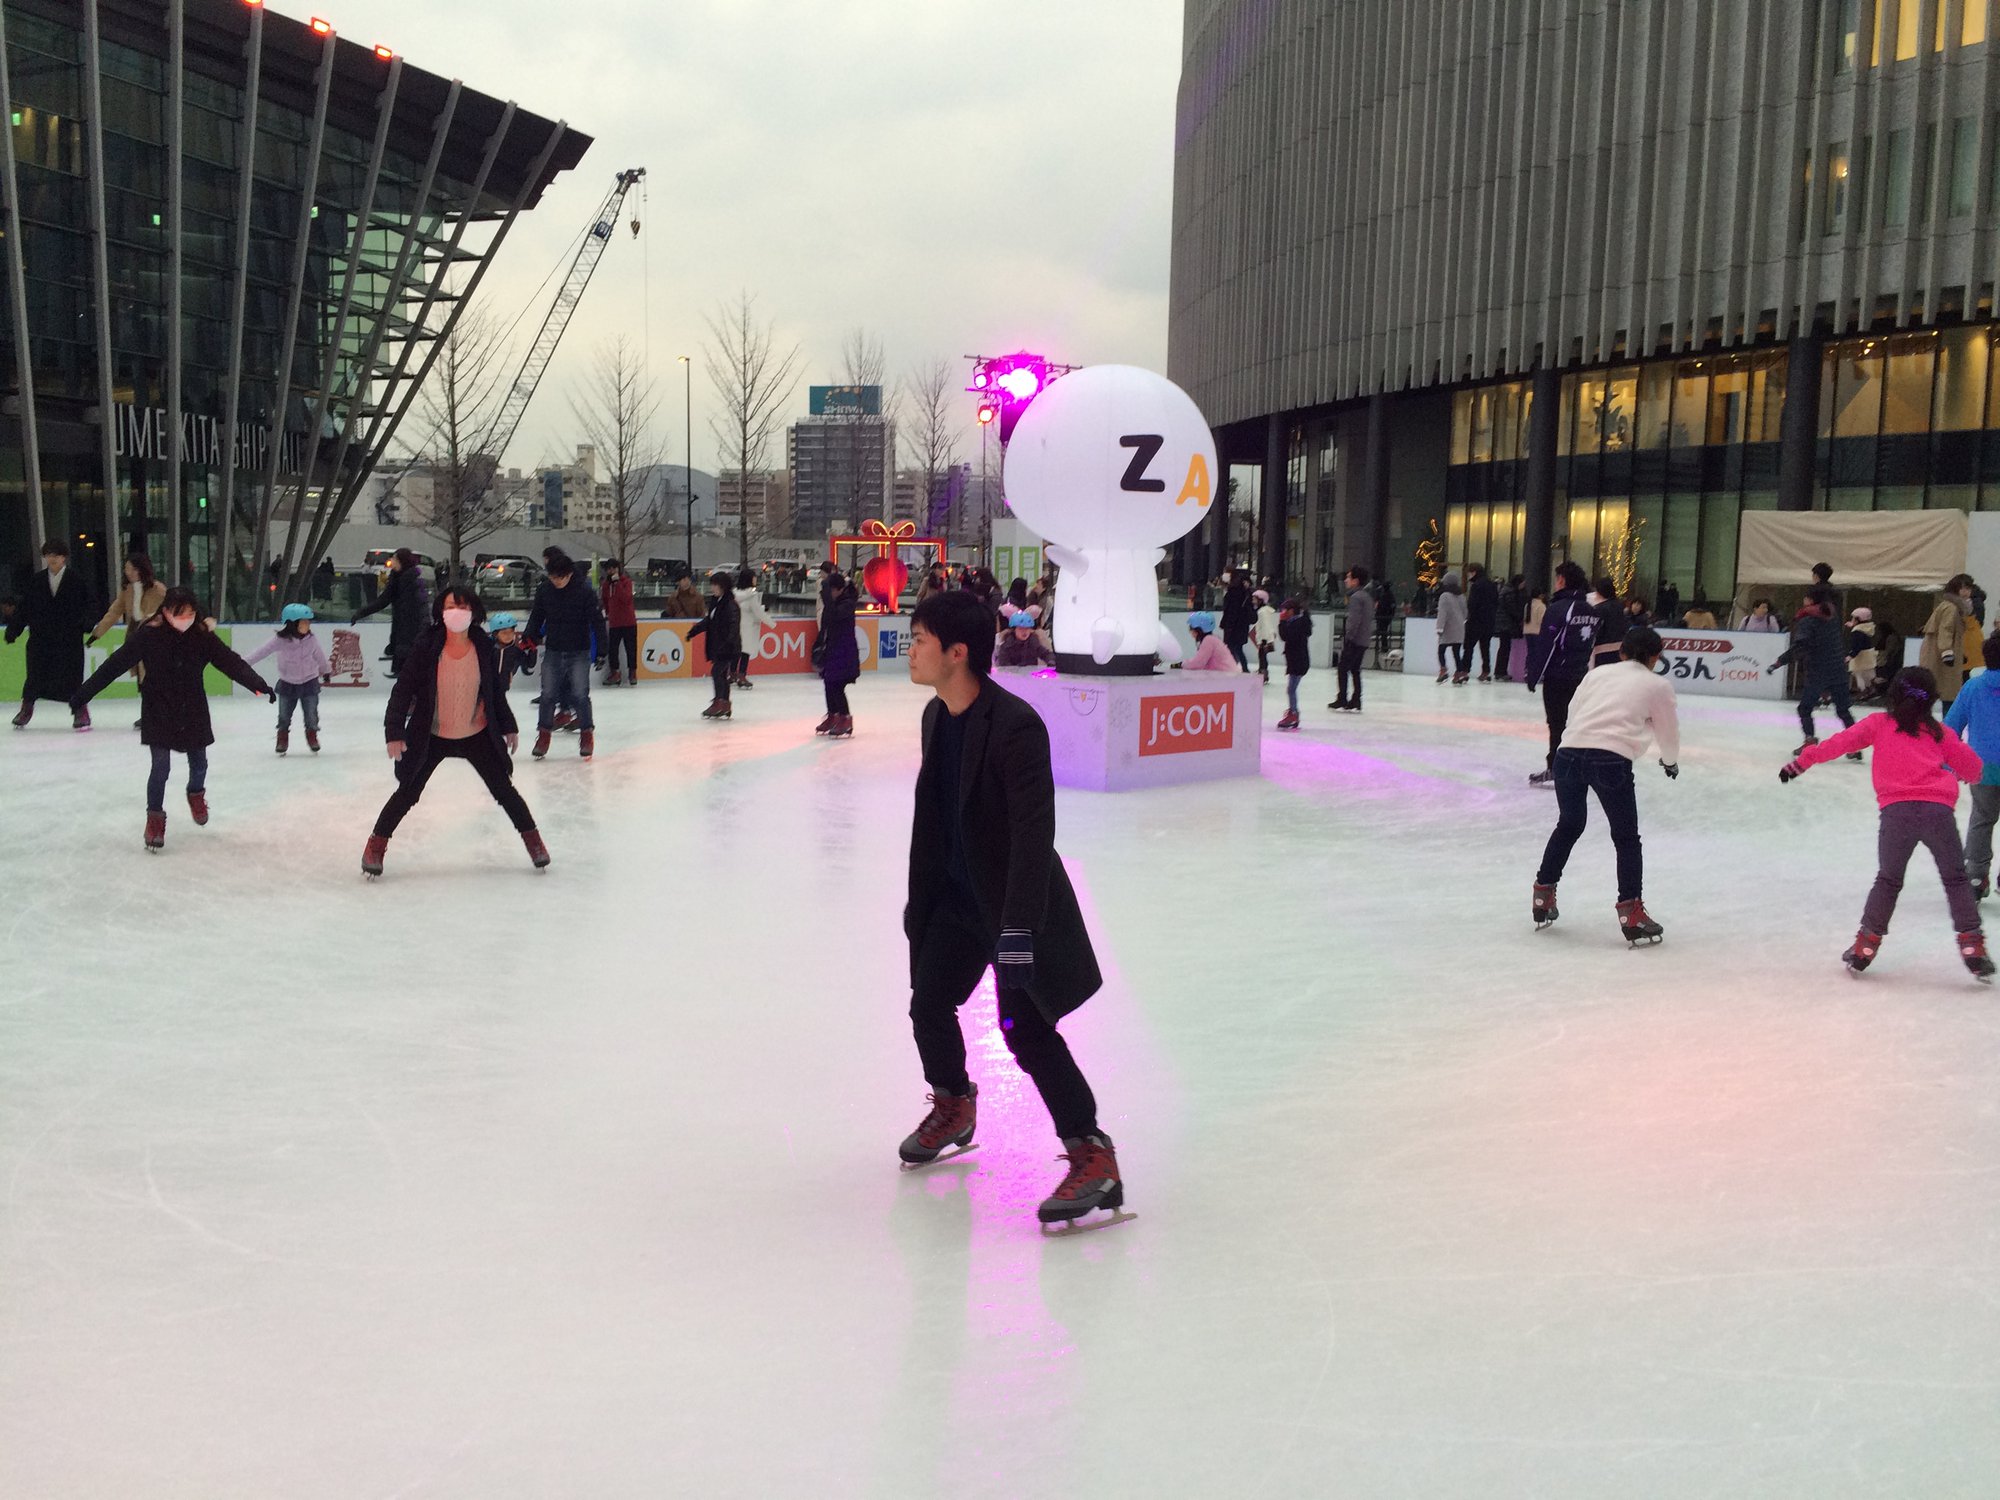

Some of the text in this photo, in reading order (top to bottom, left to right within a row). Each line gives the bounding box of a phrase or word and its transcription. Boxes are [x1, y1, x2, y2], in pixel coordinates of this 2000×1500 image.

[281, 430, 303, 476] ALL
[646, 647, 681, 665] ZAQ
[1147, 702, 1228, 746] J:COM
